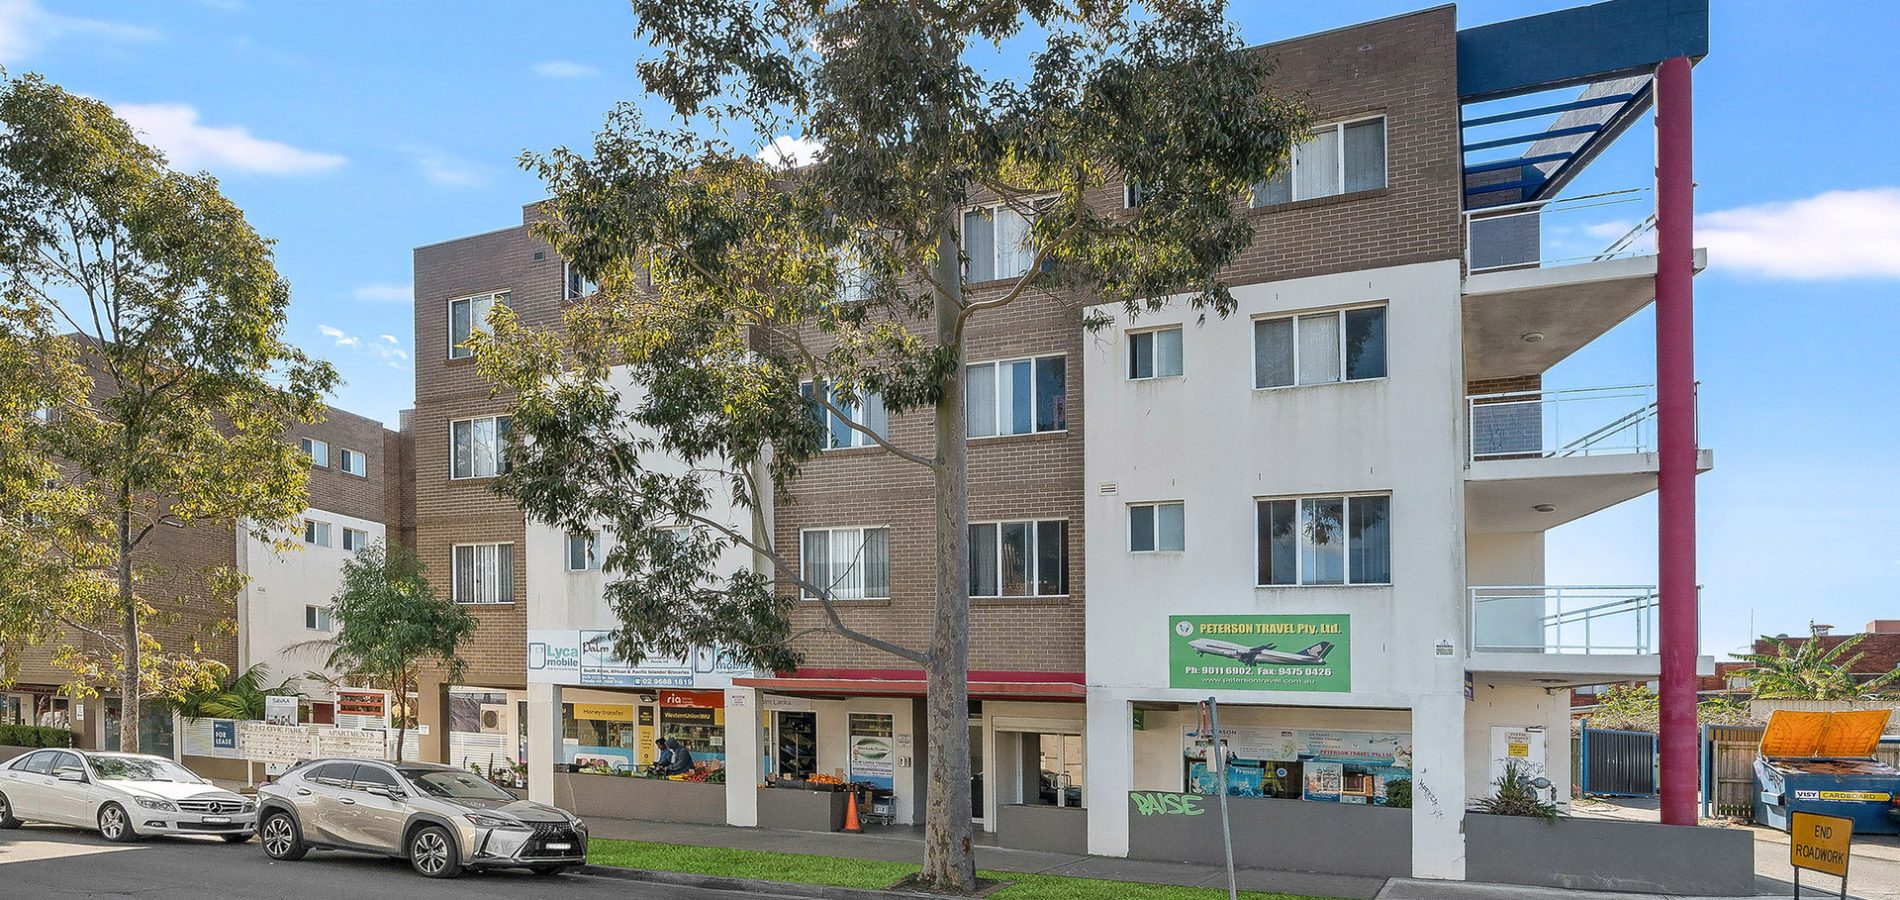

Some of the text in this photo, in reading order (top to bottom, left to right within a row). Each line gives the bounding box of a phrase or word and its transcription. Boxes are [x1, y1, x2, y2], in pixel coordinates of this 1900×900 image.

[1199, 623, 1342, 636] PETERSON TRAVEL Pty. Ltd.
[546, 644, 578, 659] Lyca
[582, 641, 609, 655] Palm
[546, 657, 578, 667] mobile
[1185, 666, 1201, 675] Ph:
[1201, 667, 1223, 675] 9011
[1257, 667, 1277, 676] Fax:
[1279, 668, 1303, 676] 9475
[1305, 668, 1333, 676] 0426
[1201, 676, 1316, 685] www.petersontravel.com.au
[666, 693, 682, 704] ria
[328, 729, 375, 738] APARTMENTS
[215, 738, 232, 746] LEASE
[1822, 792, 1876, 800] CARDBOARD
[1814, 825, 1833, 839] END
[1795, 844, 1845, 864] ROADWORK
